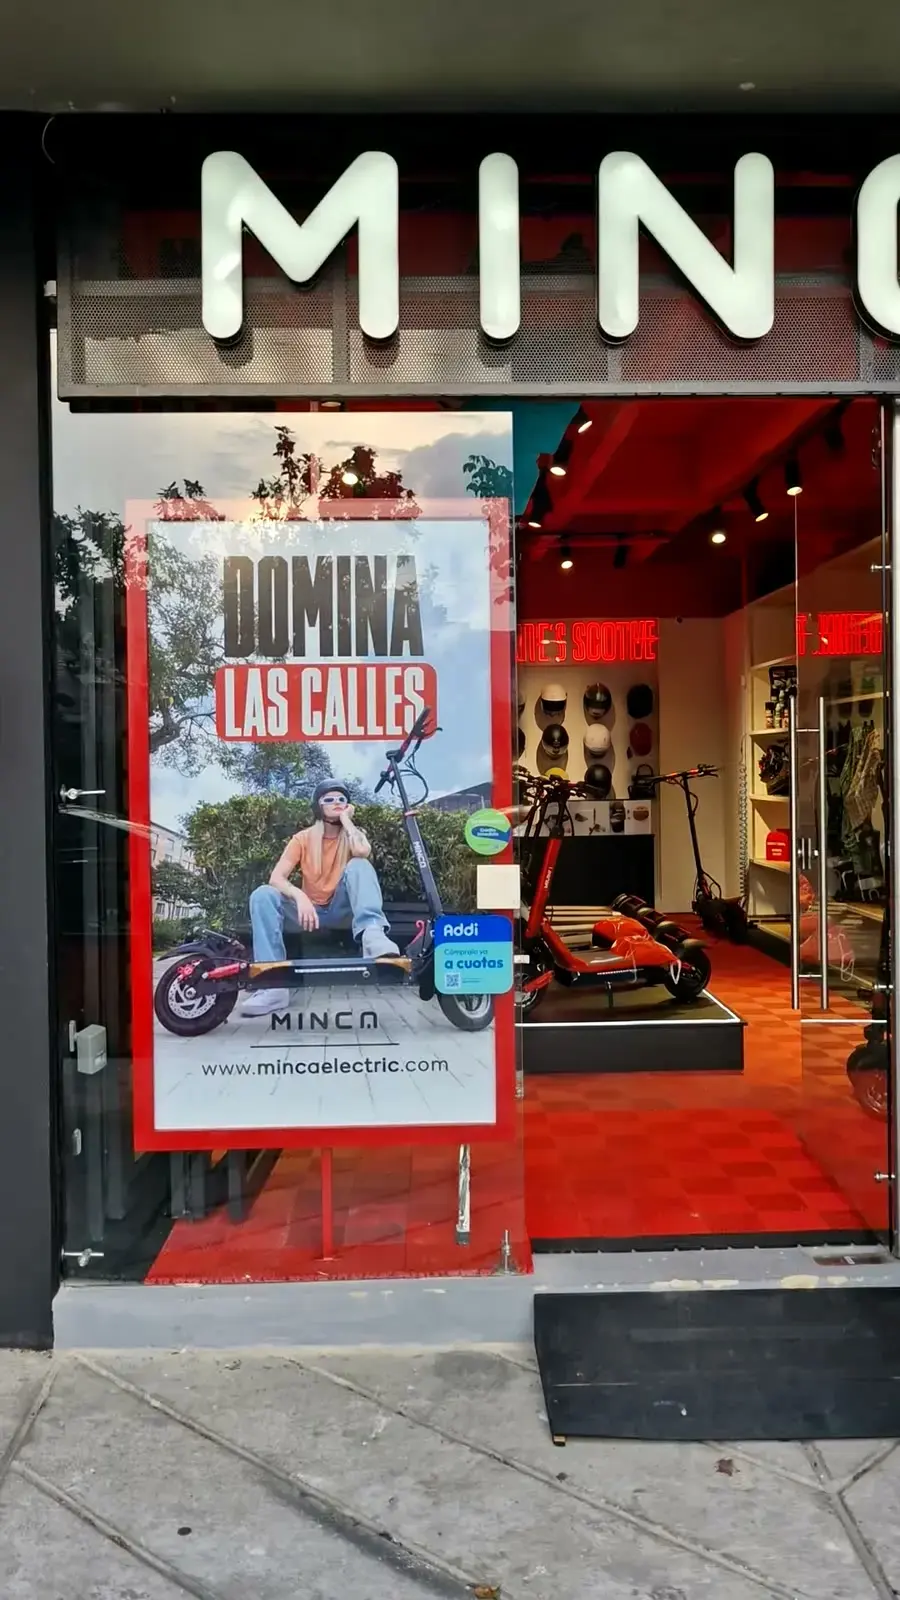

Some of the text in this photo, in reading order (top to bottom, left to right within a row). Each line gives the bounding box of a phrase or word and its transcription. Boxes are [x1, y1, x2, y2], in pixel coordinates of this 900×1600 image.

[223, 555, 424, 657] DOMINA
[224, 667, 424, 737] LAS CALLES
[443, 922, 479, 937] Addi
[444, 957, 504, 969] a cuotas
[271, 1011, 379, 1031] MINCA
[201, 1057, 449, 1076] www.mincaelectric.com
